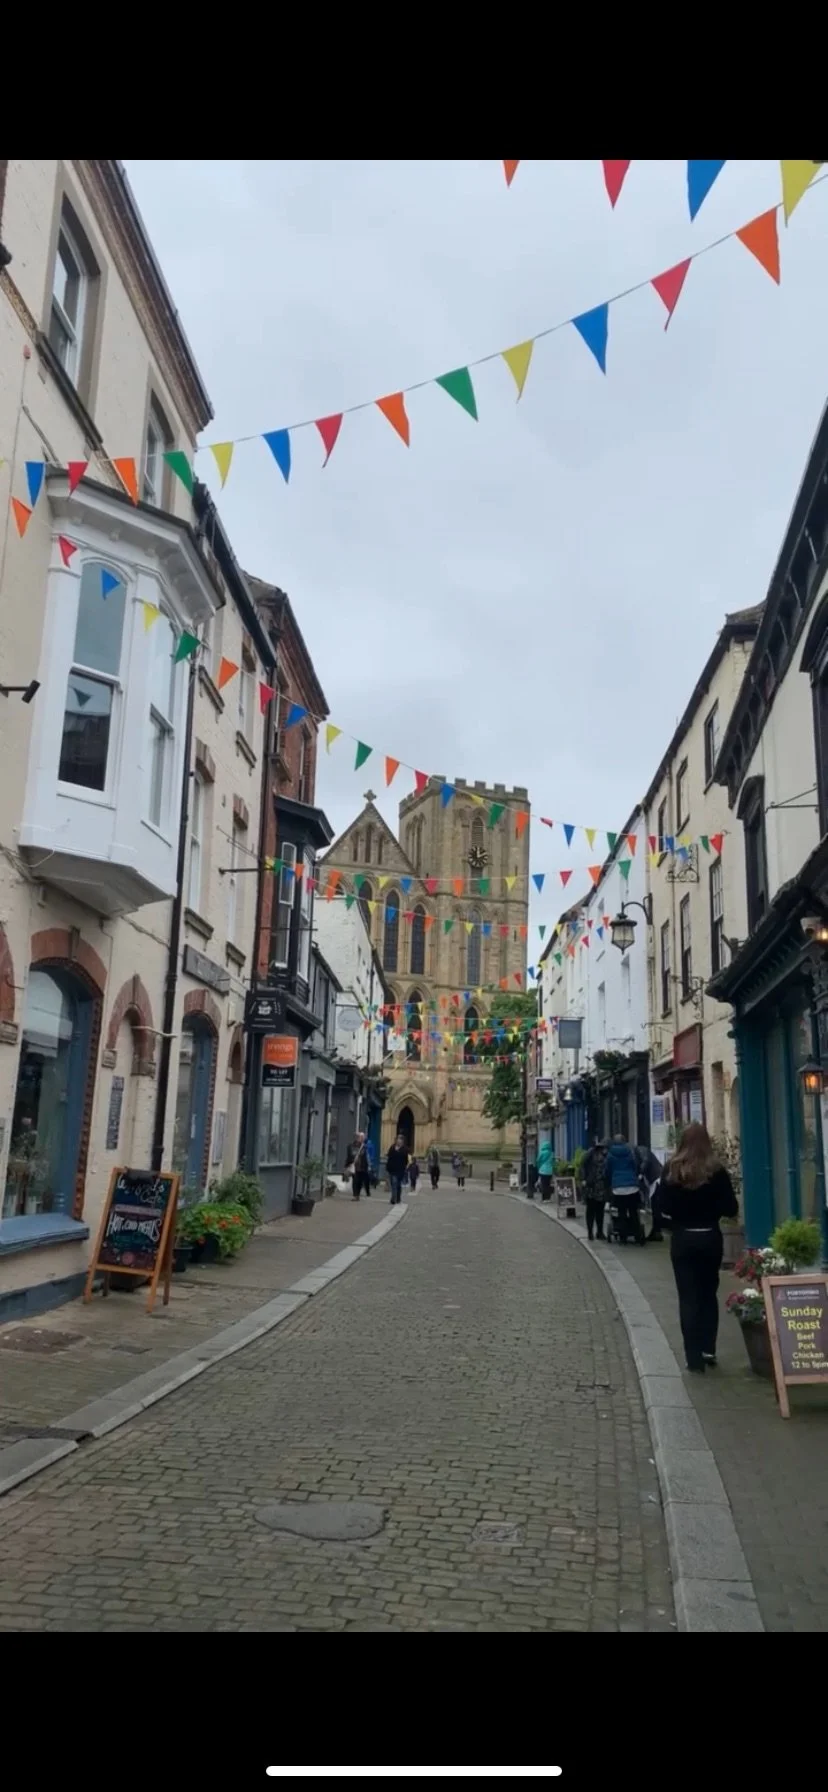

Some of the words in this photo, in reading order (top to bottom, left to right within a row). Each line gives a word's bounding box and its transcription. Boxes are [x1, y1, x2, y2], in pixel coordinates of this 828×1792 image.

[780, 1306, 823, 1318] Sunday
[787, 1319, 821, 1331] Roast
[796, 1332, 815, 1341] Beef
[798, 1342, 816, 1350] Pork
[792, 1351, 825, 1360] Chicken
[791, 1361, 801, 1369] 12
[802, 1361, 811, 1369] to
